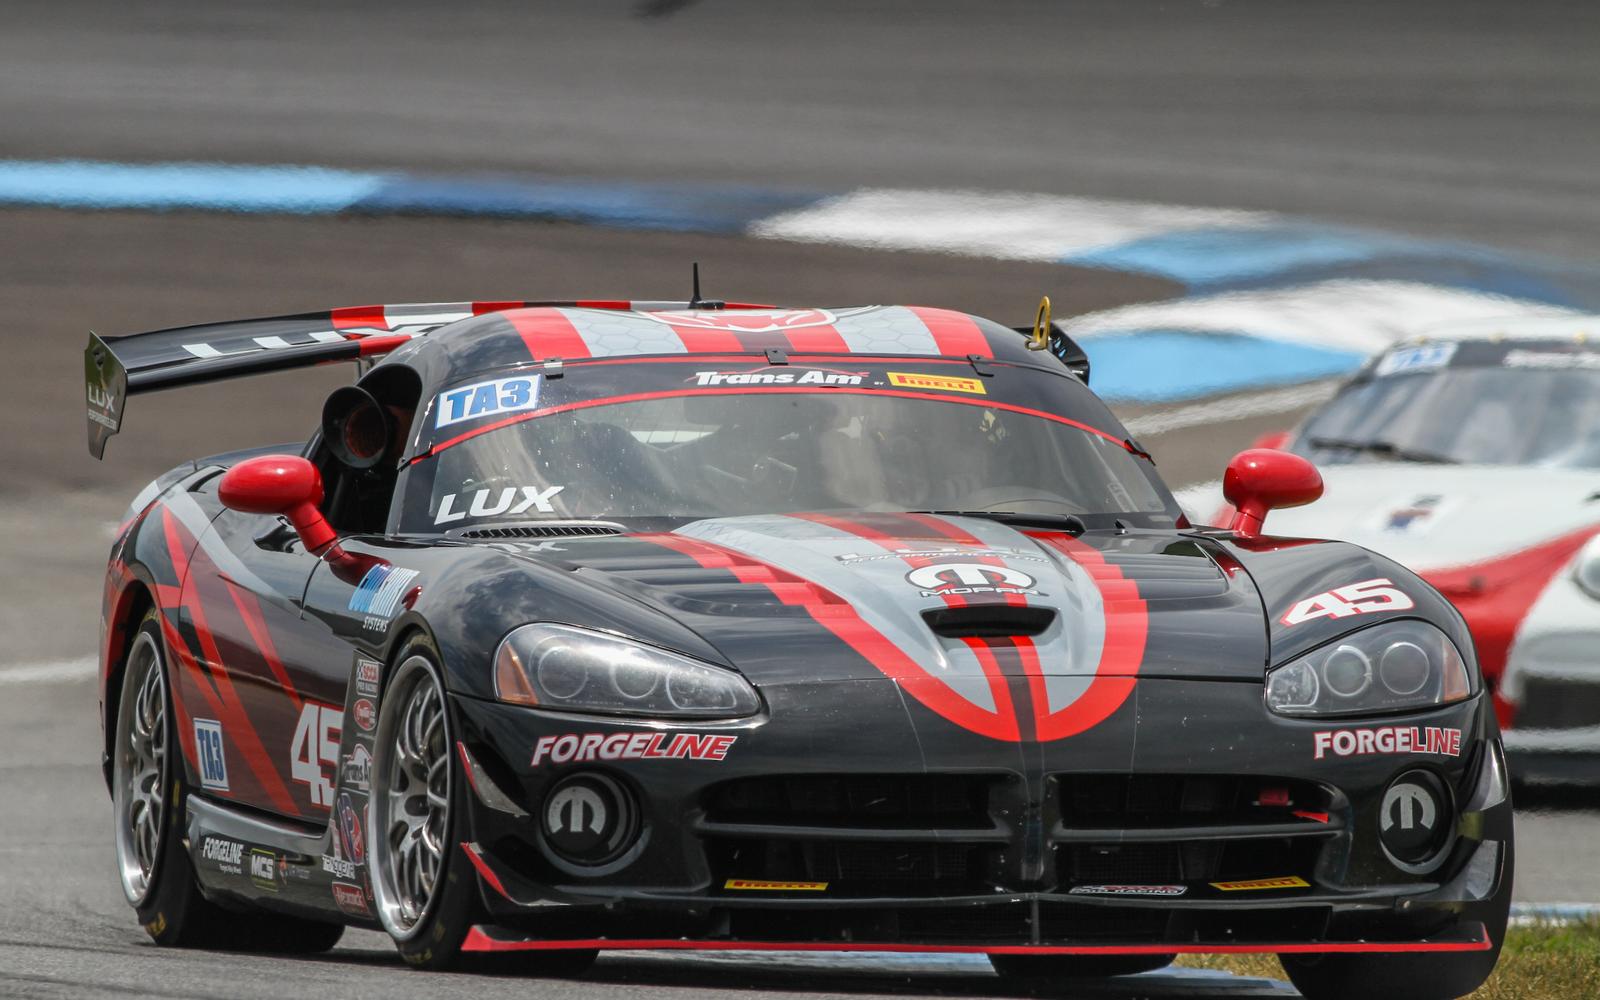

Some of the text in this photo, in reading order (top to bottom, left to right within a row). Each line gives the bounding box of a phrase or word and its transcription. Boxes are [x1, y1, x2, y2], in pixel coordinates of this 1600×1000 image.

[695, 371, 793, 386] Trans
[796, 370, 863, 385] Am
[895, 375, 976, 391] PIRELLI
[88, 383, 115, 413] LUX
[447, 379, 531, 420] TA3
[433, 485, 565, 526] LUX
[919, 586, 1046, 598] MOPAR
[1280, 578, 1416, 627] 45
[362, 615, 389, 633] SYSTEMS
[197, 727, 225, 782] TA3
[290, 700, 345, 807] 45
[531, 732, 738, 767] FORGELINE
[1313, 726, 1462, 760] FORGELINE
[203, 837, 244, 865] FORGELINE
[252, 855, 274, 879] MCS
